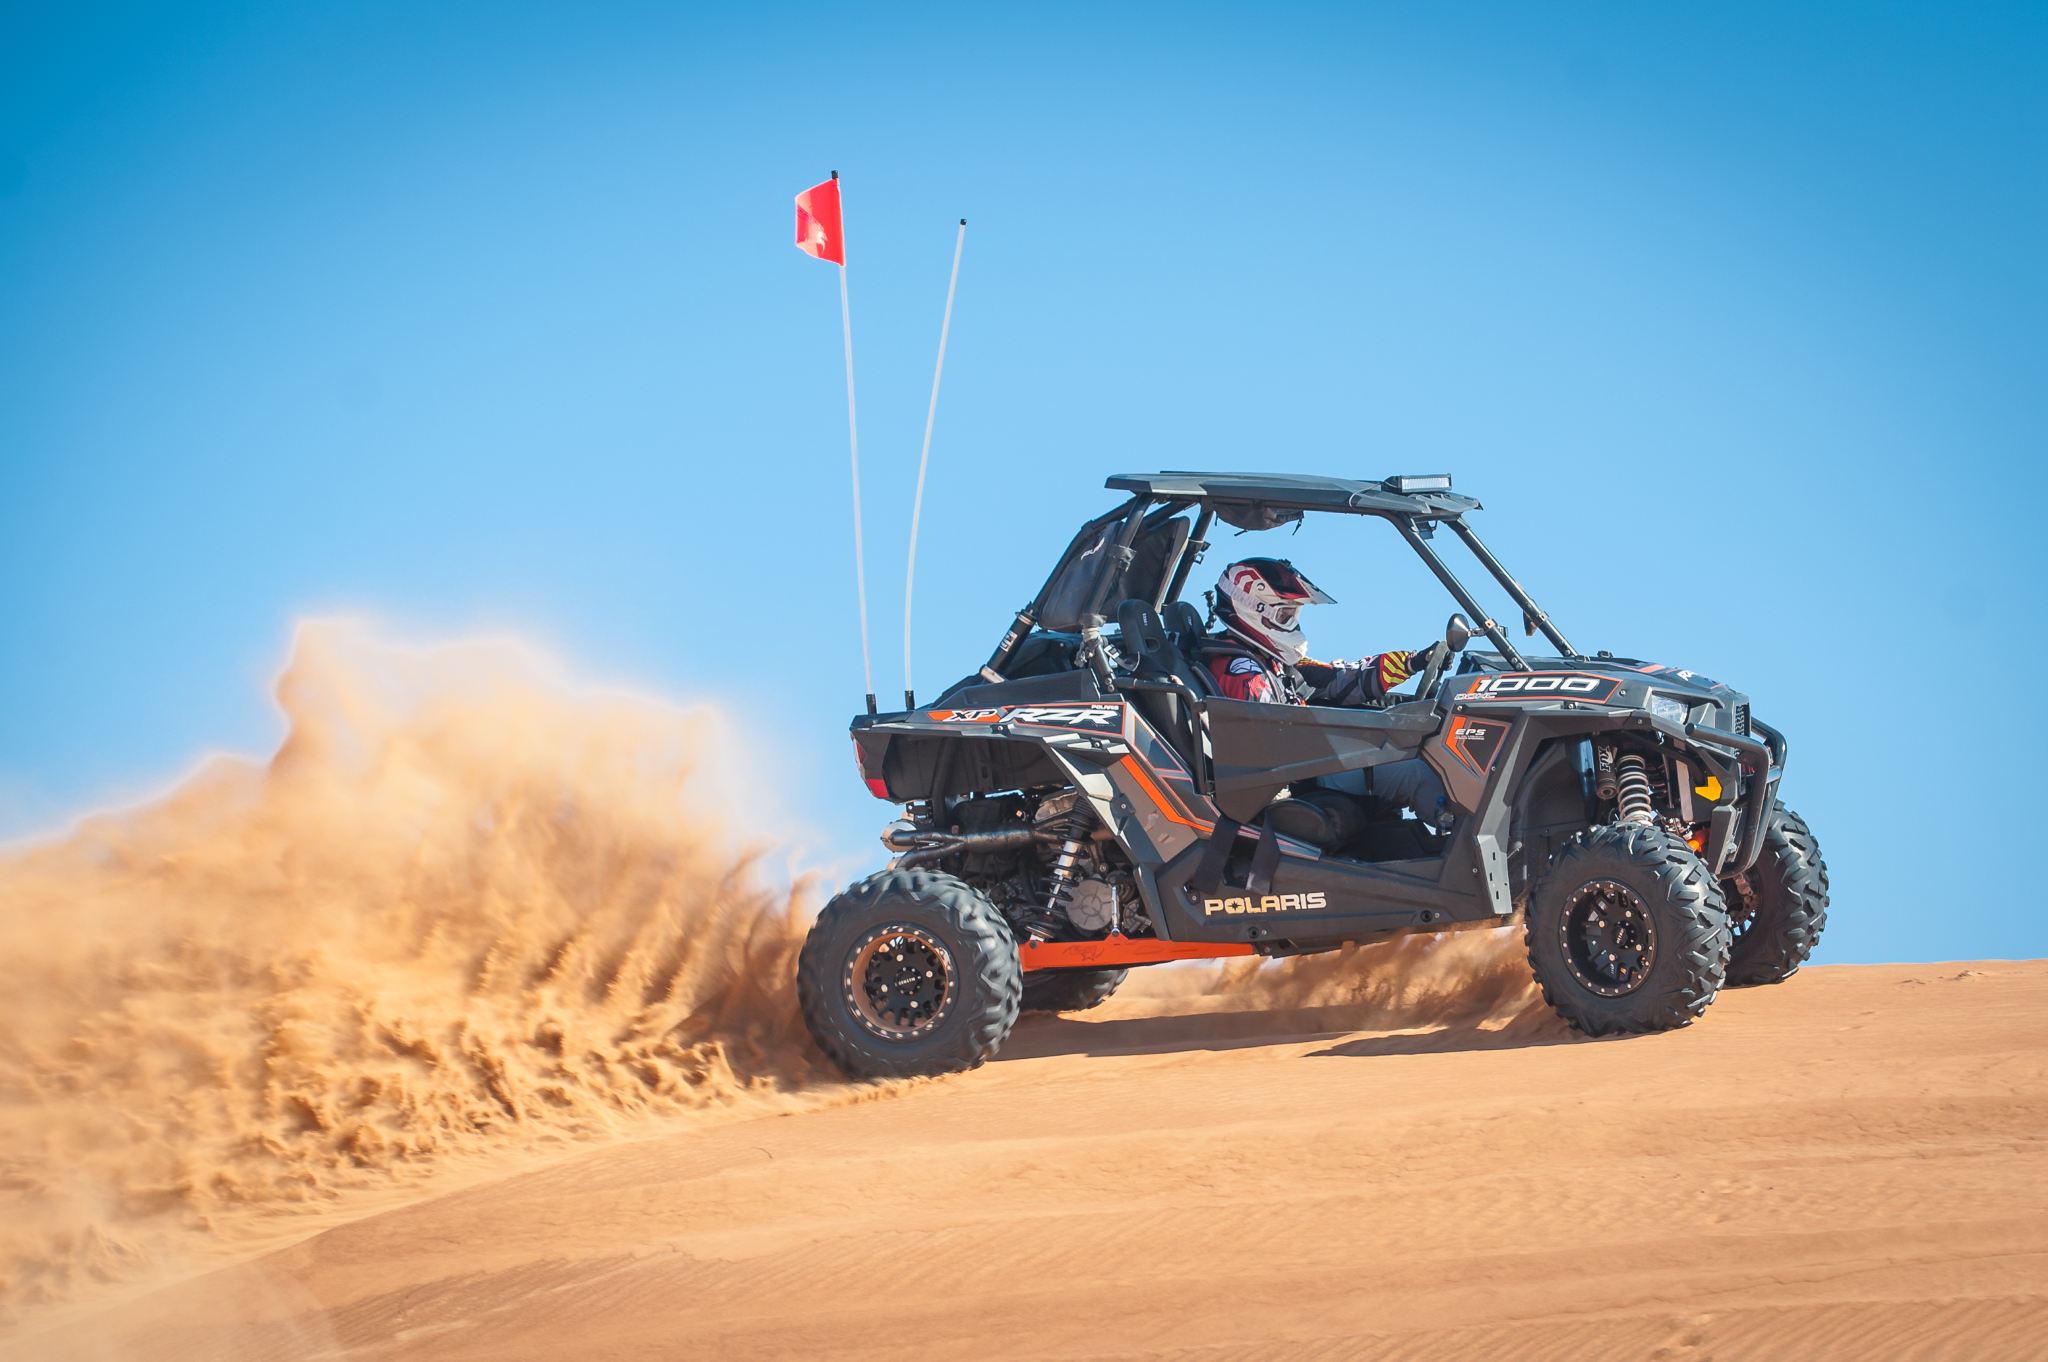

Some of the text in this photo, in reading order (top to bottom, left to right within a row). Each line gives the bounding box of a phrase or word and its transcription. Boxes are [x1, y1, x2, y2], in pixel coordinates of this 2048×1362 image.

[1476, 677, 1601, 693] 1000
[942, 706, 1119, 725] XP RZR
[1455, 728, 1487, 736] EPS
[1597, 745, 1612, 773] FOX
[1204, 892, 1327, 916] POLARIS
